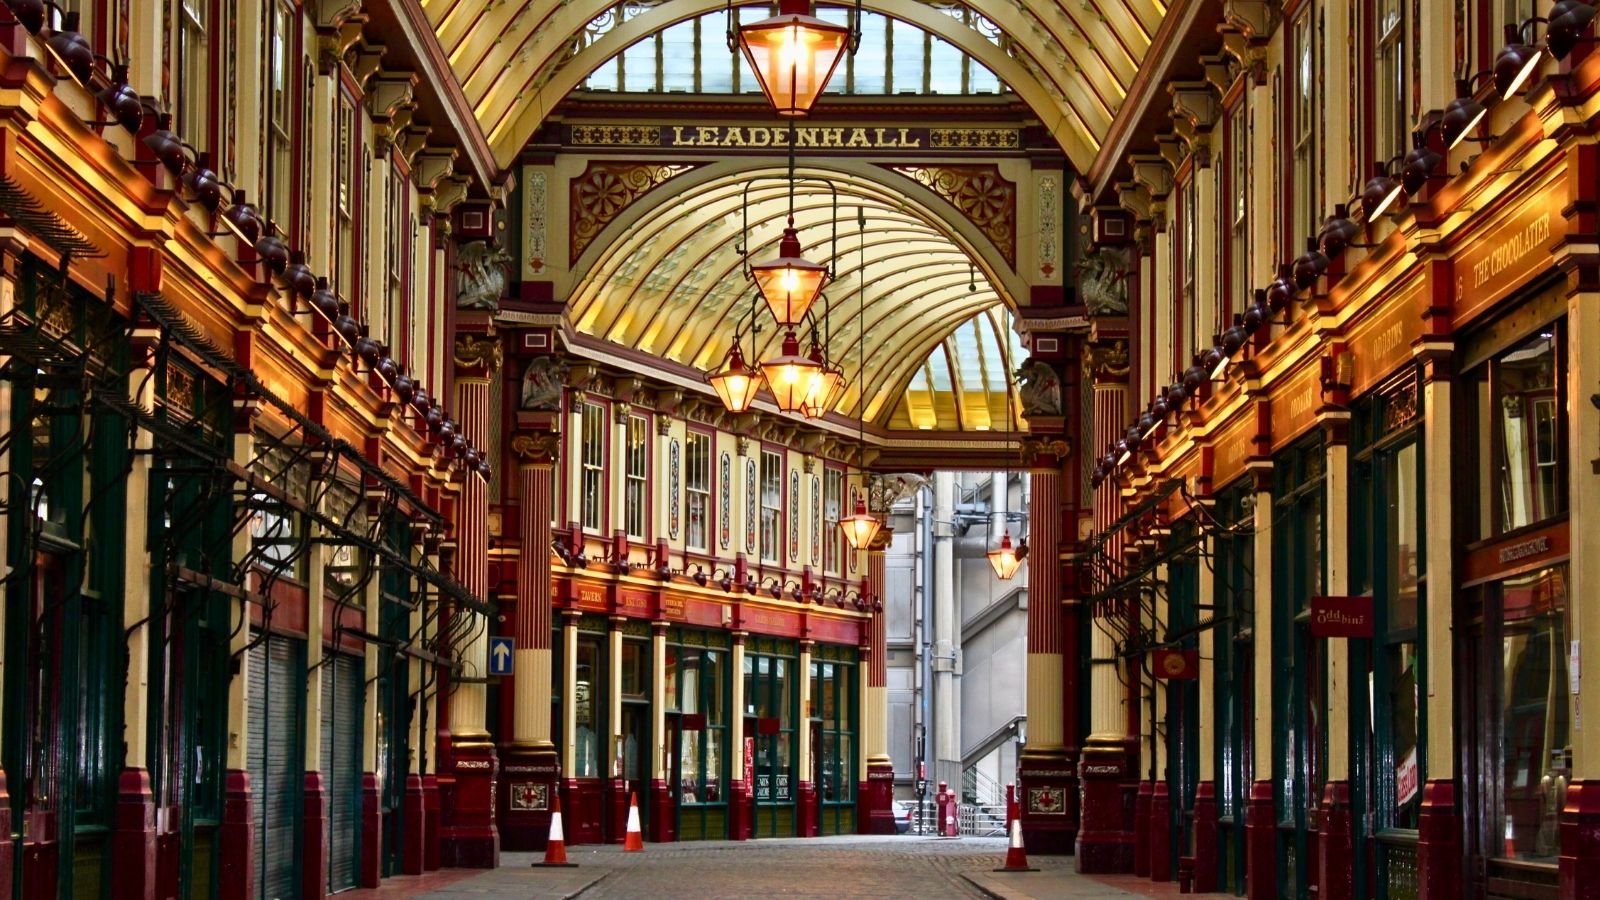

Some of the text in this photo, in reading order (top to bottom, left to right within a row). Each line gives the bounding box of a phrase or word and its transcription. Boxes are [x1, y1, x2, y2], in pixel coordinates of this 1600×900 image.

[672, 126, 920, 148] LEADENHALL
[1473, 211, 1550, 289] THE CHOCOLATIER
[580, 589, 602, 603] TAVERN
